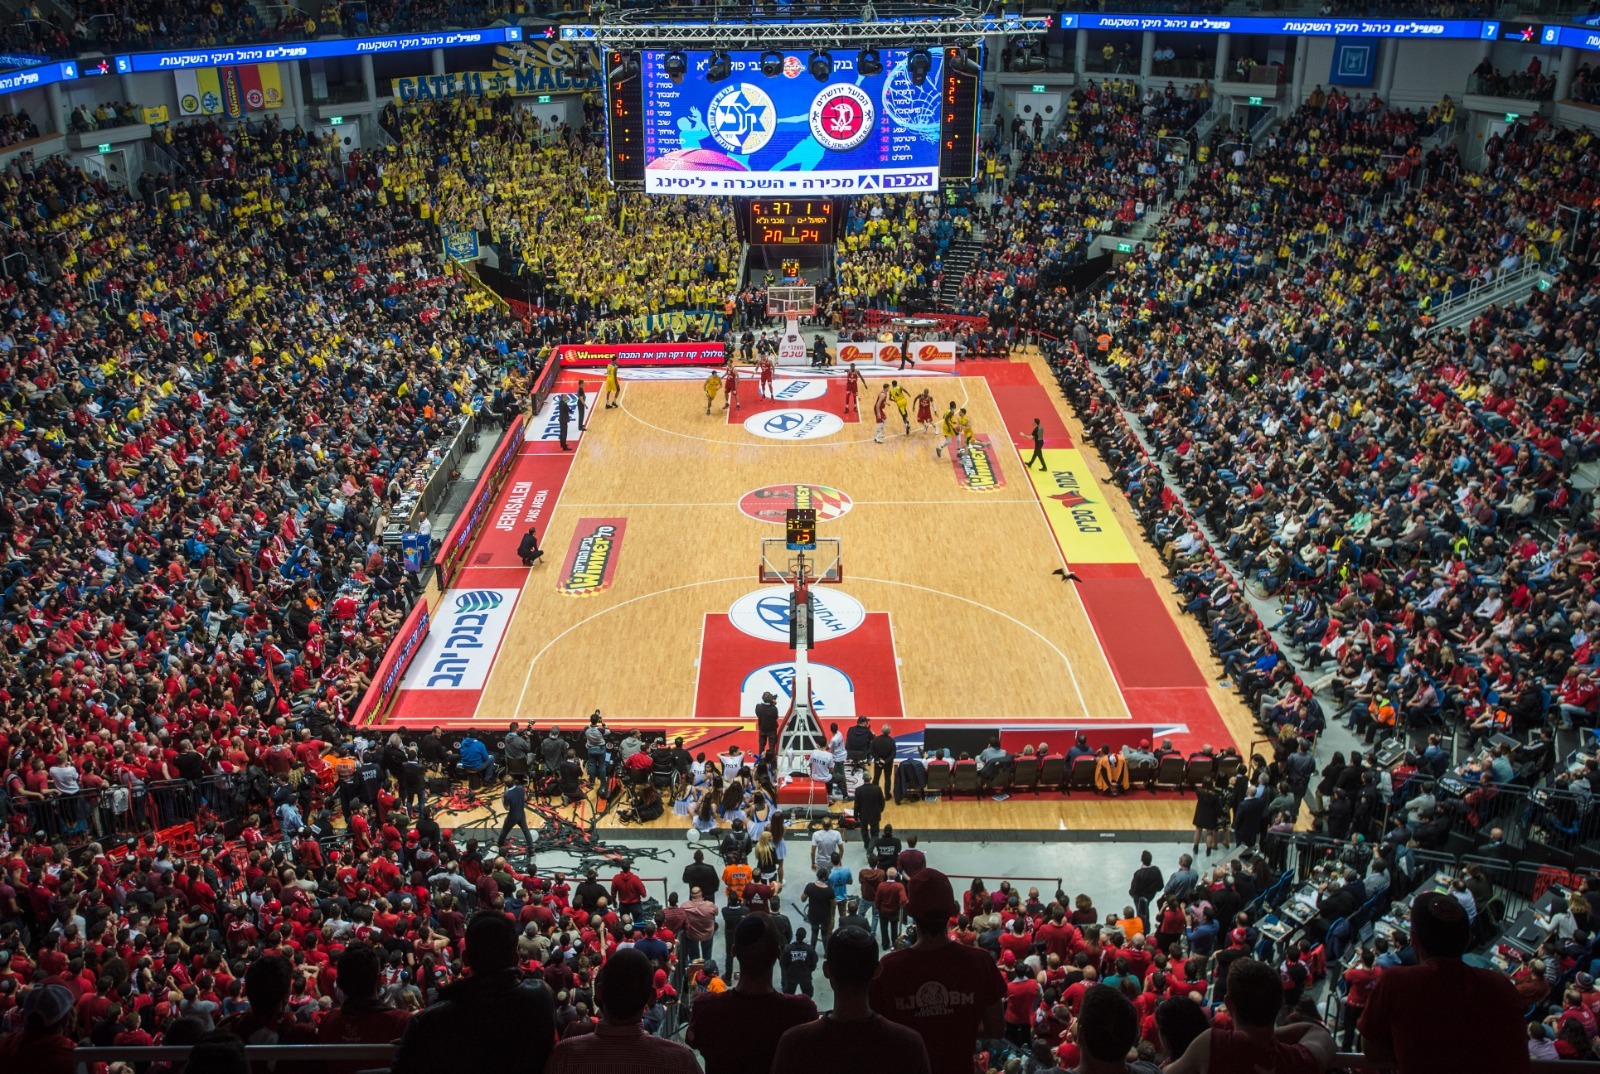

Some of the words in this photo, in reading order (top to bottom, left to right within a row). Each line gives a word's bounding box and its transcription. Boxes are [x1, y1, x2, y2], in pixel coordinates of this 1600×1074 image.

[1065, 17, 1073, 26] 7
[1099, 18, 1139, 28] השקעות
[1141, 19, 1162, 29] תיקי
[1164, 19, 1188, 28] ניהול
[1190, 19, 1231, 29] פעילים
[1282, 22, 1332, 33] השקעות
[1334, 23, 1359, 34] תיקי
[1362, 22, 1391, 33] ניהול
[1394, 22, 1444, 34] פעילים
[1487, 25, 1495, 36] 7
[446, 33, 481, 43] פעילים
[511, 30, 518, 39] 5
[1545, 30, 1555, 41] 8
[356, 41, 397, 51] השקעות
[400, 39, 419, 49] תיקי
[421, 36, 443, 46] ניהול
[237, 51, 263, 60] ניהול
[266, 47, 307, 58] פעילים
[160, 55, 208, 66] השקעות
[211, 53, 234, 64] תיקי
[66, 65, 72, 75] 4
[120, 61, 126, 71] 5
[833, 60, 853, 73] בנק
[13, 73, 39, 87] פעילים
[398, 73, 456, 102] GATE
[816, 87, 844, 107] ירושלים
[848, 86, 869, 107] הפועל
[814, 125, 831, 146] HAPOEL
[655, 176, 706, 189] ליסינג
[723, 178, 785, 189] השכרה
[803, 176, 854, 189] מכירה
[886, 174, 929, 187] אלבר
[577, 351, 615, 360] Winner
[668, 351, 684, 360] דקה
[686, 351, 698, 360] קח
[531, 489, 549, 509] ARENA
[1052, 471, 1080, 489] צומת
[1072, 509, 1102, 533] ספרים
[495, 481, 533, 532] JERUSALEM
[524, 509, 540, 523] PAIS
[569, 537, 610, 588] Winner
[444, 613, 488, 649] בנק
[426, 652, 469, 687] יהב
[949, 991, 975, 1006] BM
